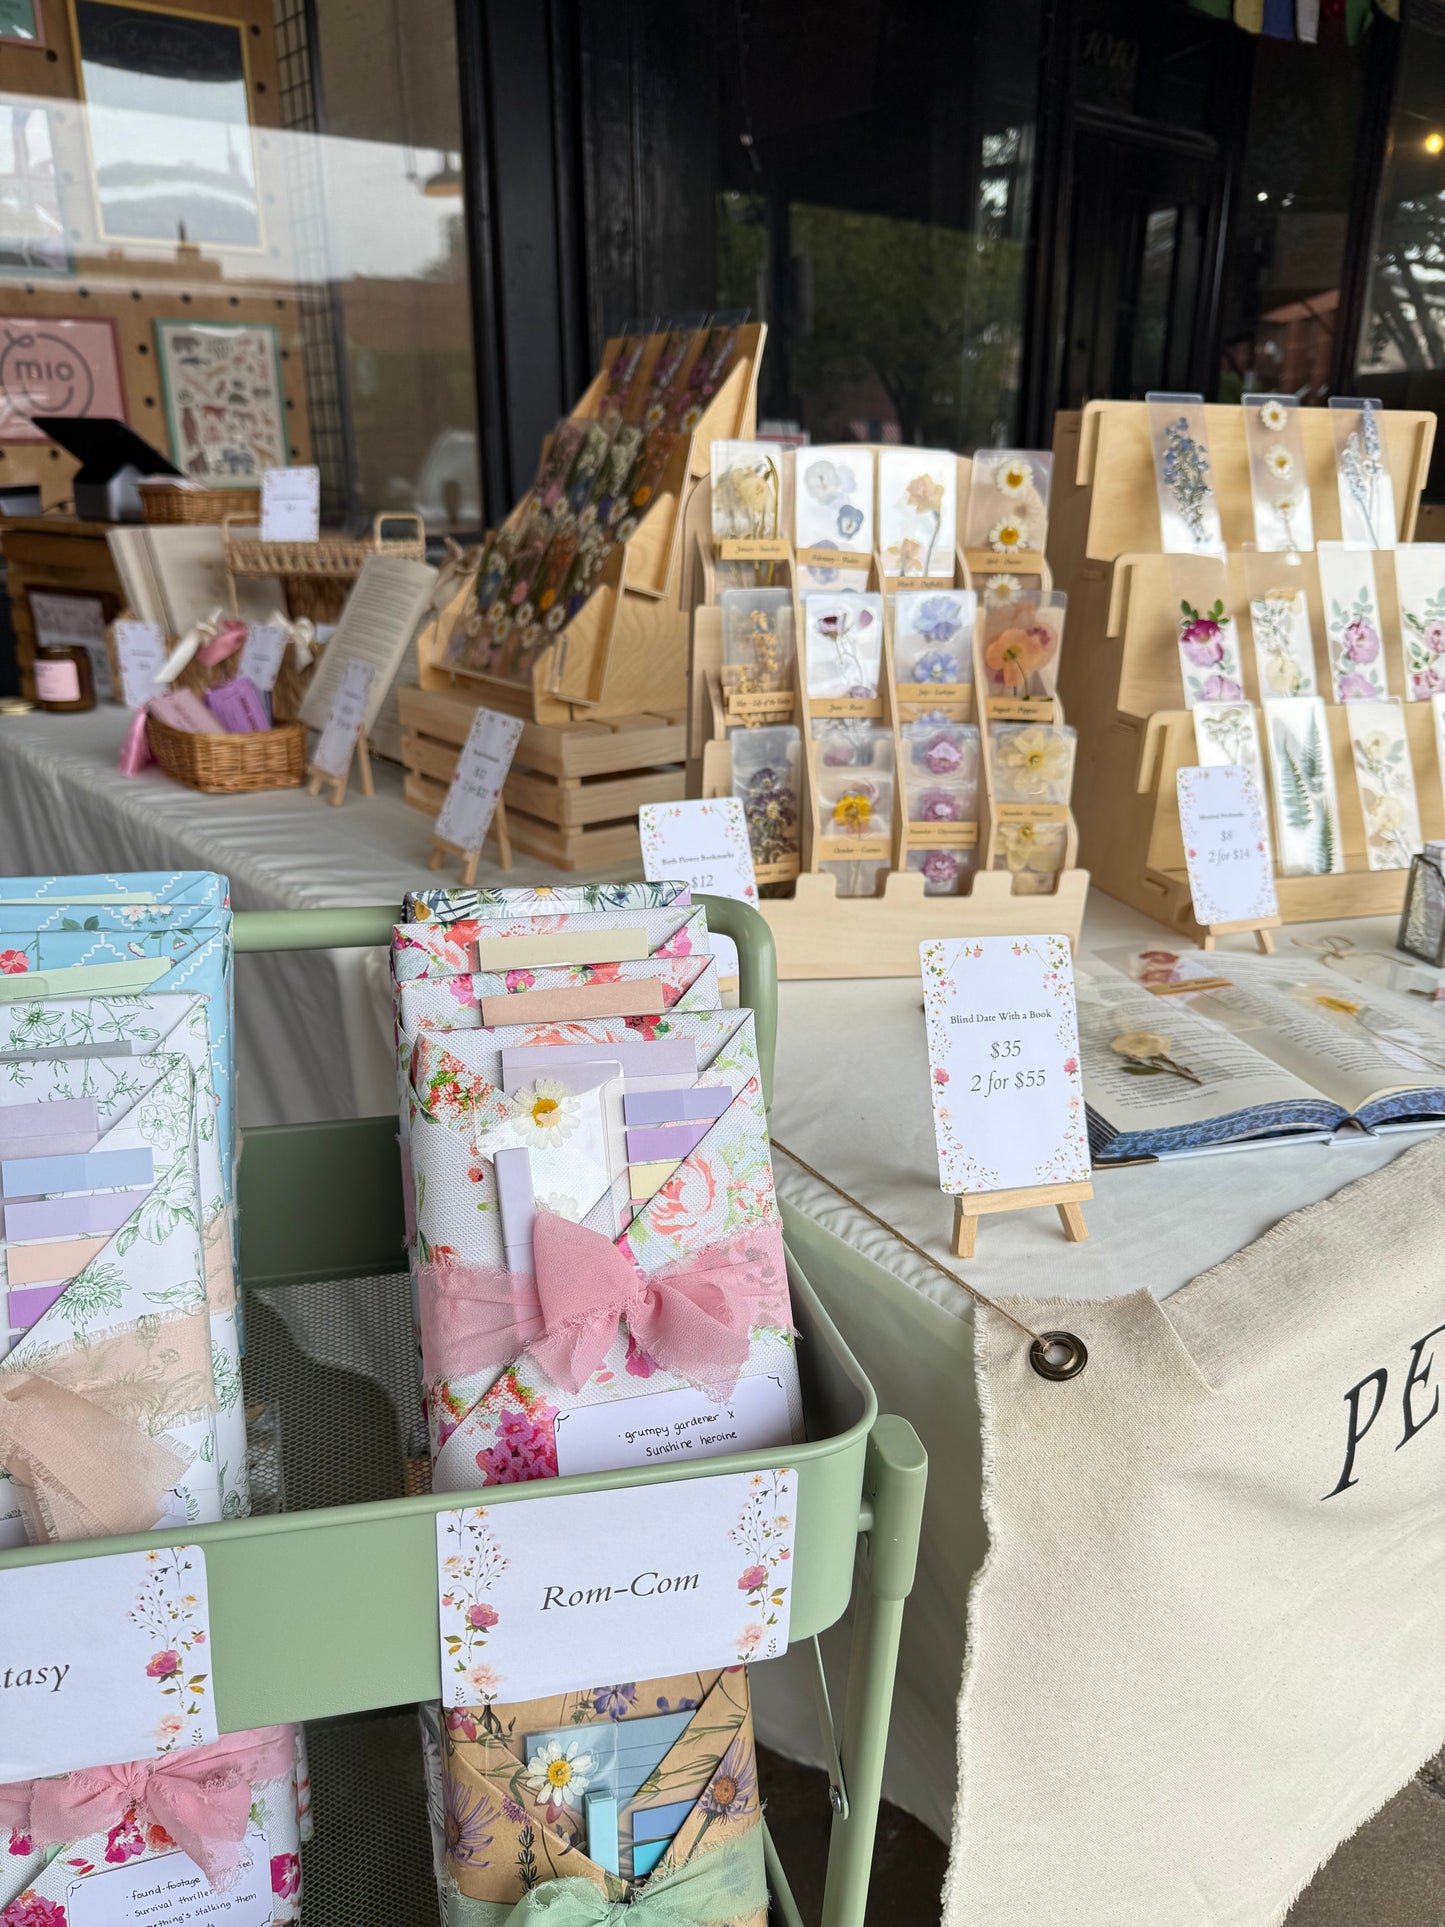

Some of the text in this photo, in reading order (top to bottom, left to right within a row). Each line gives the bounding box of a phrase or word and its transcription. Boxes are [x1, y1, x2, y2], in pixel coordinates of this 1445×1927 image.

[15, 360, 74, 382] mio
[679, 856, 700, 864] Flower
[701, 851, 735, 862] Bookmarks
[1208, 849, 1216, 863] 2
[1216, 847, 1230, 867] for
[691, 874, 714, 889] $12
[950, 1014, 974, 1024] Blind
[976, 1013, 996, 1023] Date
[998, 1010, 1021, 1021] With
[1029, 1008, 1052, 1019] Book
[990, 1040, 1021, 1061] $35
[970, 1069, 1046, 1098] 2 for $55
[625, 1424, 669, 1443] grumpy
[674, 1413, 719, 1435] gardener
[700, 1431, 738, 1445] heroine
[540, 1572, 699, 1610] Rom-Com
[0, 1664, 70, 1692] tasy
[131, 1876, 200, 1900] found-footage
[178, 1888, 215, 1904] thriller
[195, 1901, 232, 1916] stalking
[235, 1893, 257, 1904] them
